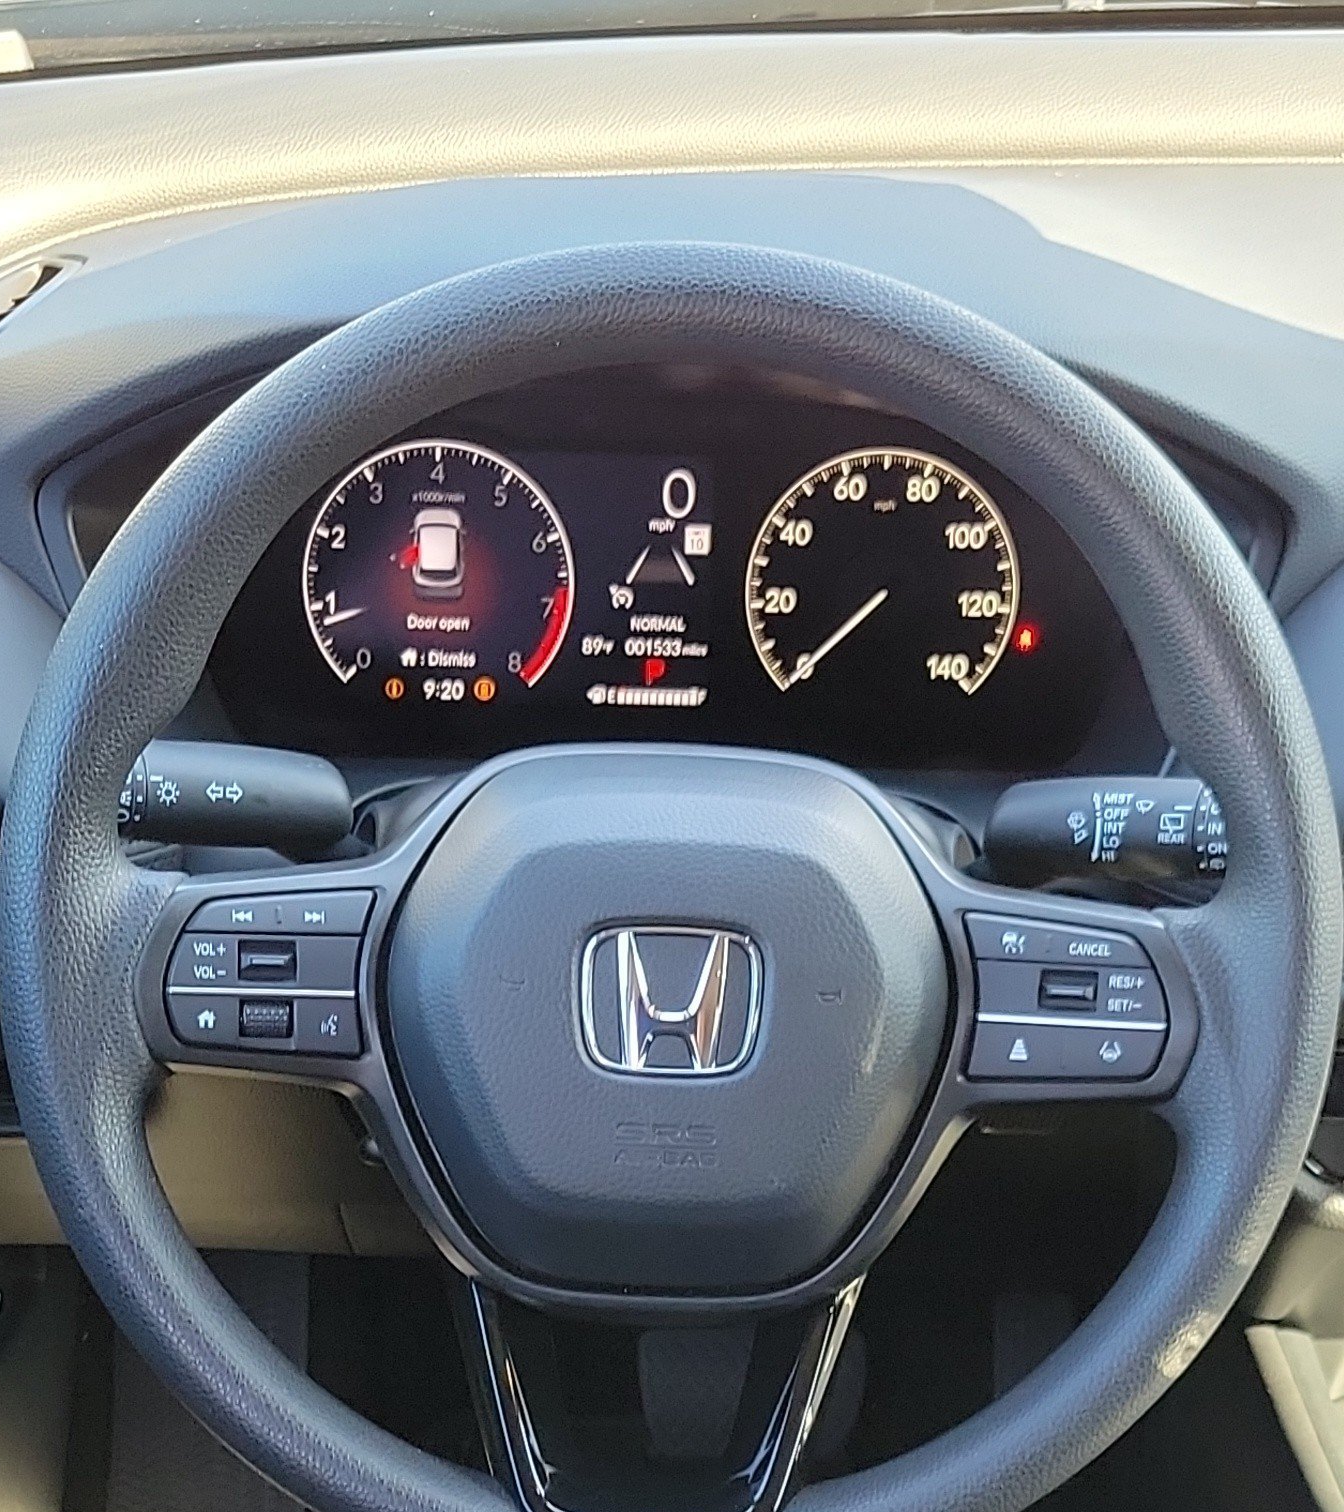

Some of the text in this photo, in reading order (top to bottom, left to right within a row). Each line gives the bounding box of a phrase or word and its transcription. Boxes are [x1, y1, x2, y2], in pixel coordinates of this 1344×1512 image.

[430, 463, 445, 484] 4
[369, 482, 384, 504] 3
[494, 485, 507, 507] 5
[662, 468, 697, 519] 0
[833, 473, 867, 501] 60
[906, 474, 940, 502] 80
[331, 524, 346, 549] 2
[532, 532, 546, 553] 6
[779, 518, 813, 547] 40
[945, 521, 988, 550] 100
[325, 590, 336, 614] 1
[764, 586, 798, 614] 20
[958, 590, 1001, 618] 120
[407, 613, 470, 632] Door open
[630, 614, 687, 633] NORMAL
[624, 636, 682, 657] 001533
[356, 648, 371, 669] 0
[427, 649, 477, 667] Dismiss
[508, 651, 522, 673] 8
[926, 653, 970, 680] 140
[423, 678, 465, 700] 9:20
[1103, 793, 1135, 806] MIST
[1103, 808, 1129, 820] OFF
[1103, 822, 1126, 835] INT
[1102, 836, 1121, 849] LO
[1068, 942, 1113, 957] CANCEL
[1108, 975, 1145, 990] RES/+
